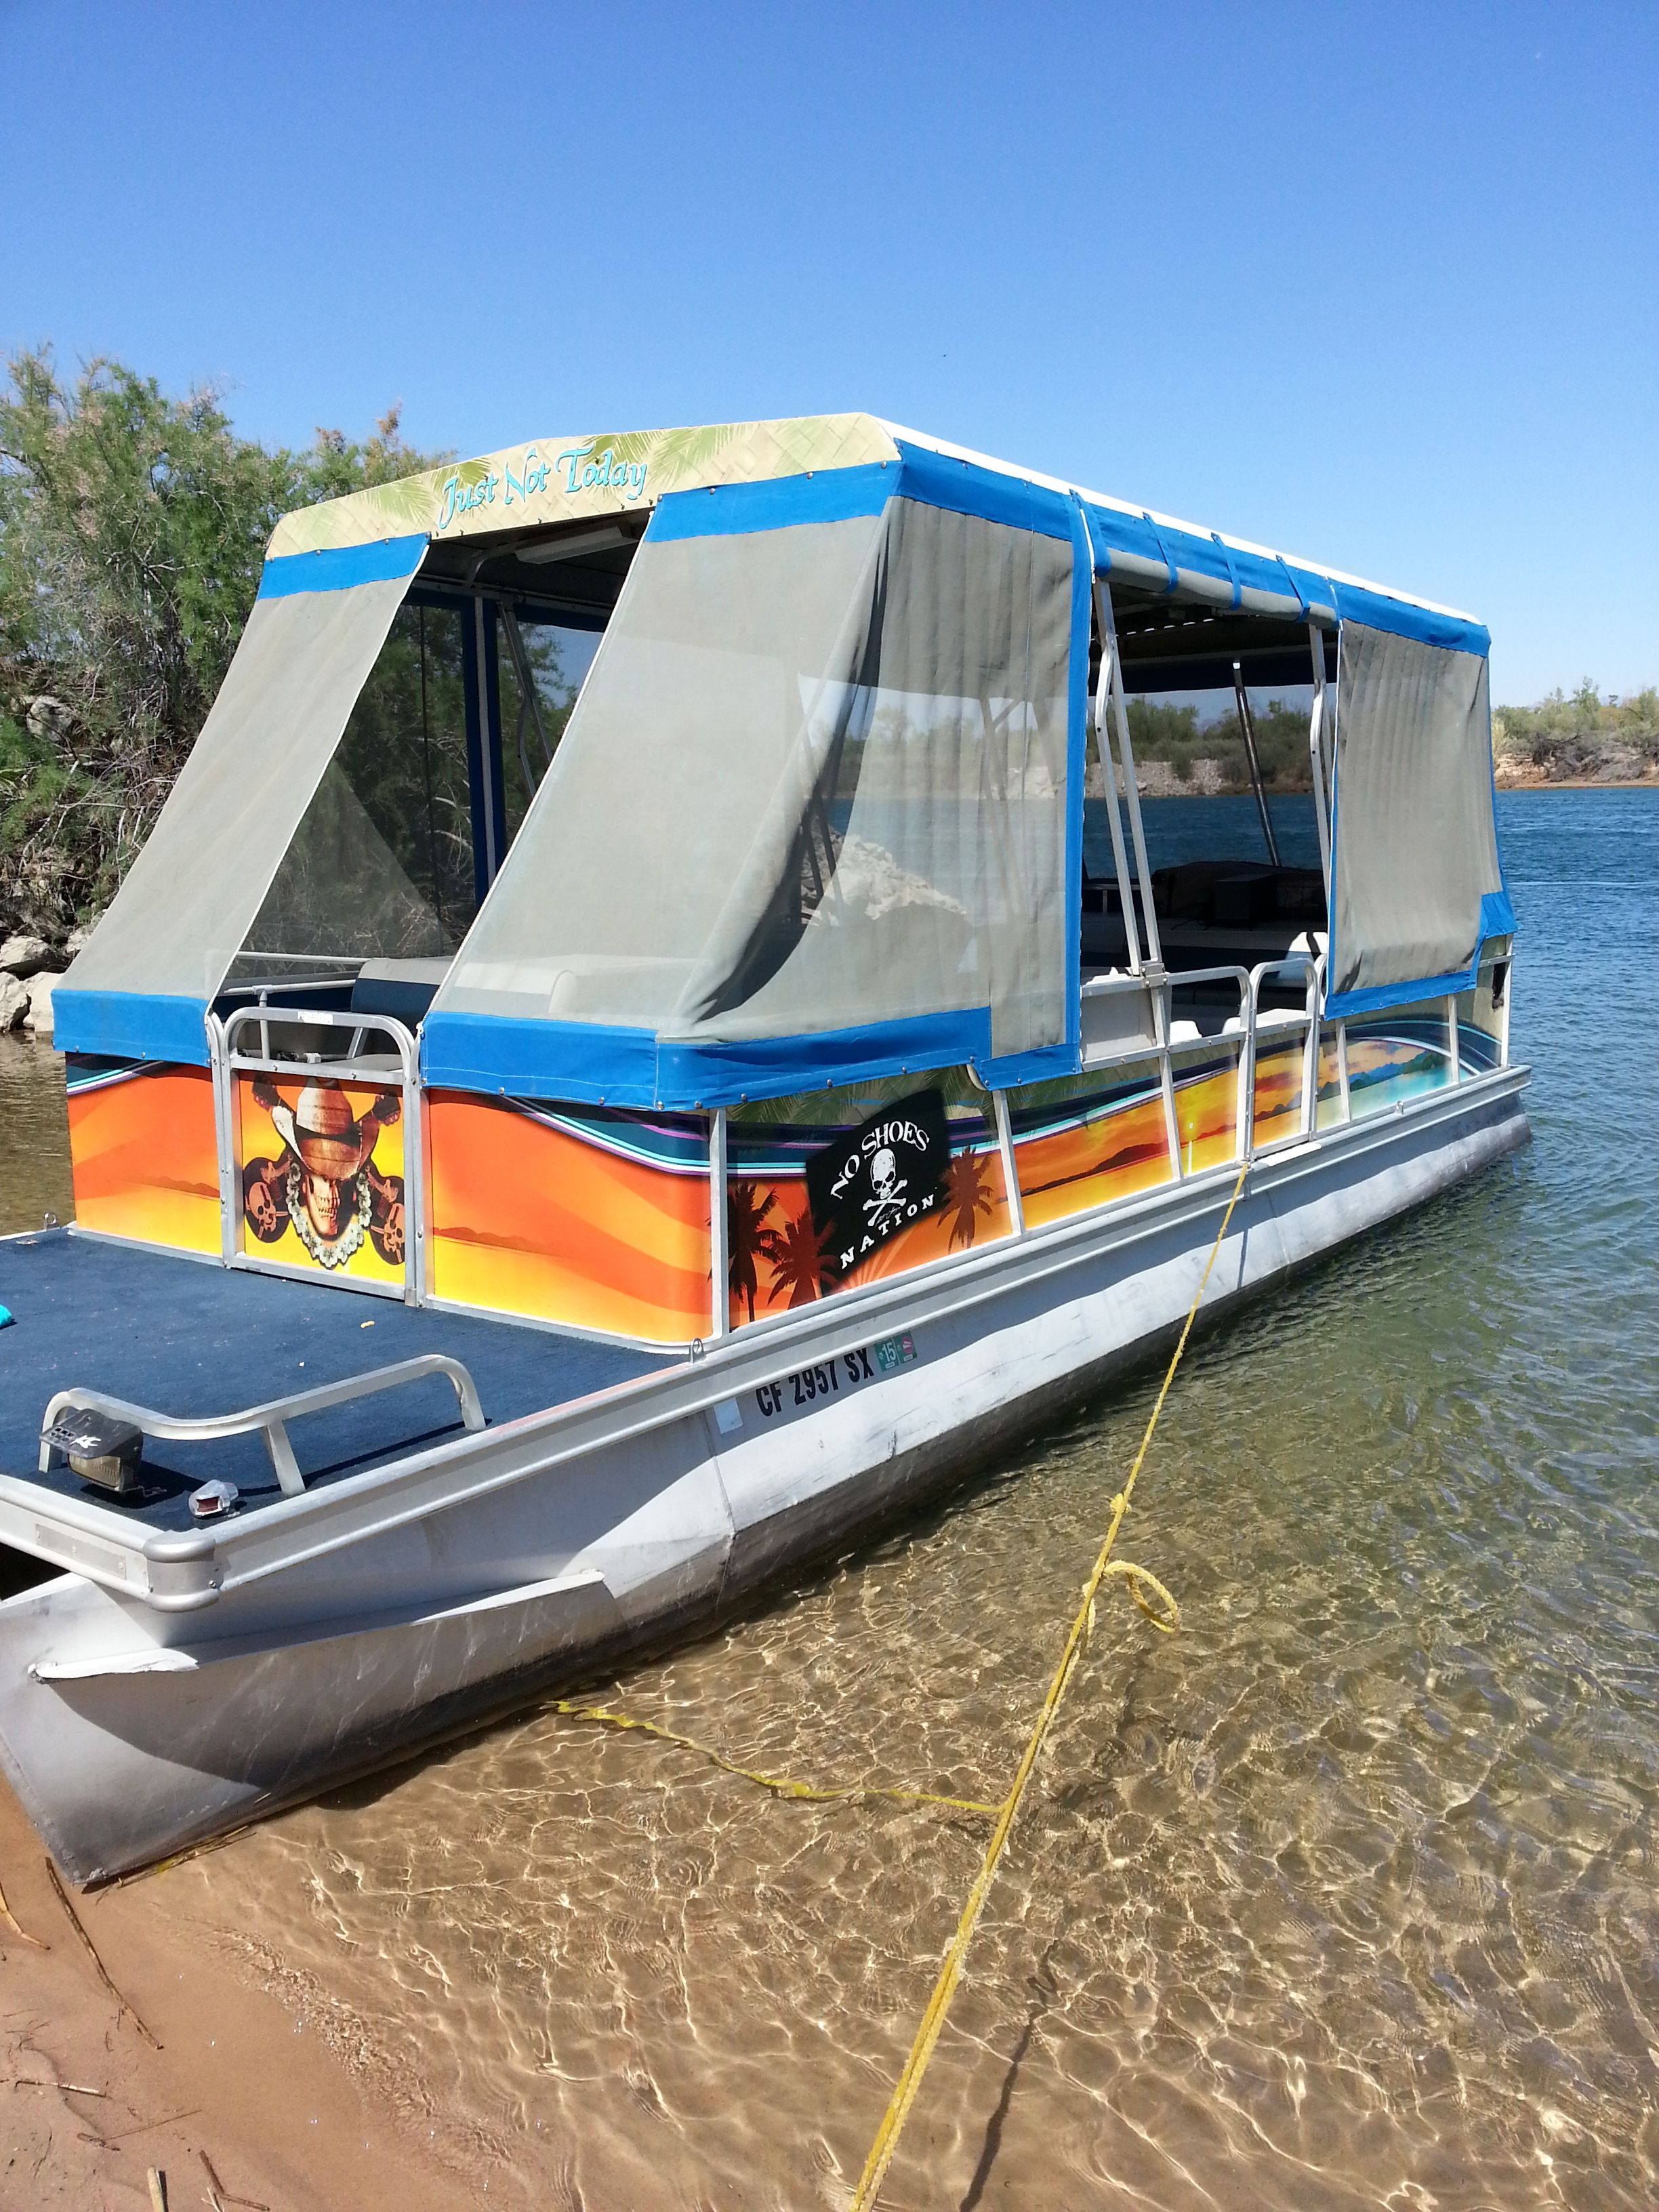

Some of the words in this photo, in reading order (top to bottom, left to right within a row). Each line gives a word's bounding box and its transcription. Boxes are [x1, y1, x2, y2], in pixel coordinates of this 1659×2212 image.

[439, 475, 499, 529] Just
[505, 448, 550, 504] Not
[555, 443, 647, 499] Today
[830, 1154, 861, 1200] NO
[861, 1120, 930, 1160] SHOES
[840, 1194, 934, 1269] NATION
[756, 1380, 782, 1417] CF
[788, 1359, 839, 1406] 2957
[844, 1347, 874, 1383] SX
[882, 1341, 896, 1362] 15
